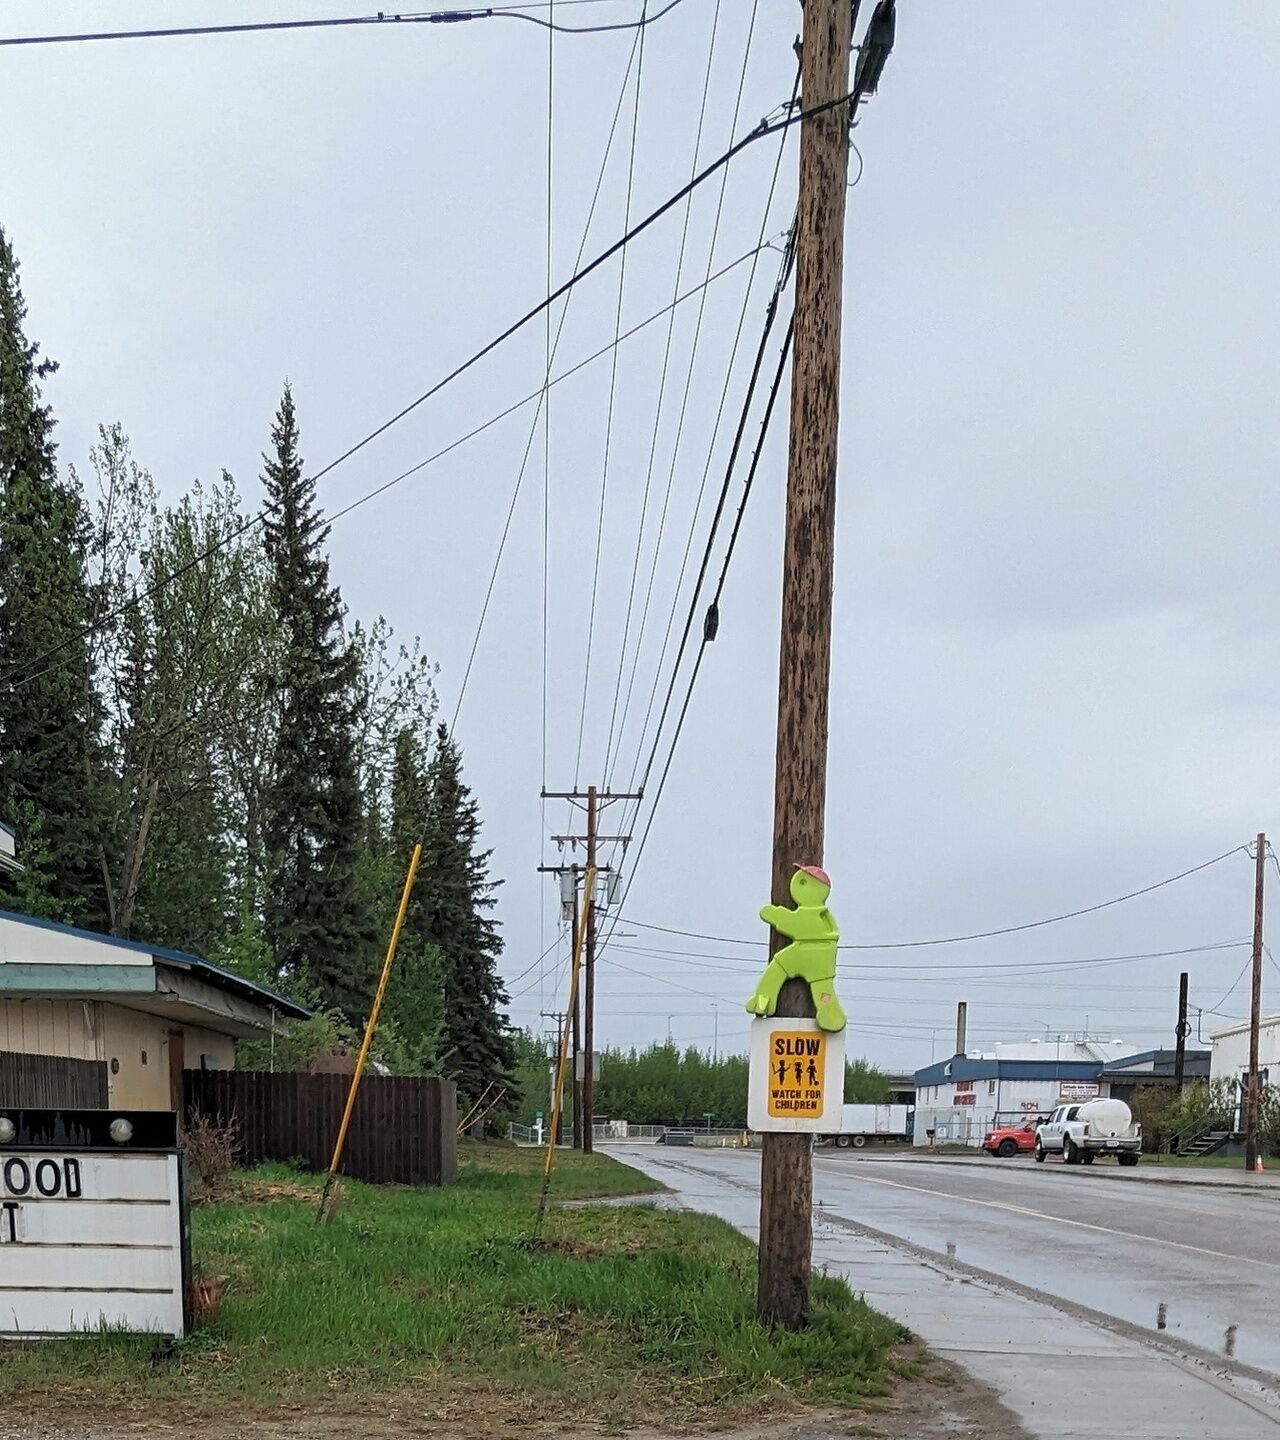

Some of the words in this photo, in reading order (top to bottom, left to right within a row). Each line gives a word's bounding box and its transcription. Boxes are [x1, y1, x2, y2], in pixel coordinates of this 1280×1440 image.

[775, 1038, 820, 1056] SLOW
[772, 1089, 801, 1099] WATCH
[805, 1089, 822, 1099] FOR
[775, 1100, 817, 1110] CHILDREN
[1021, 1102, 1038, 1110] 904
